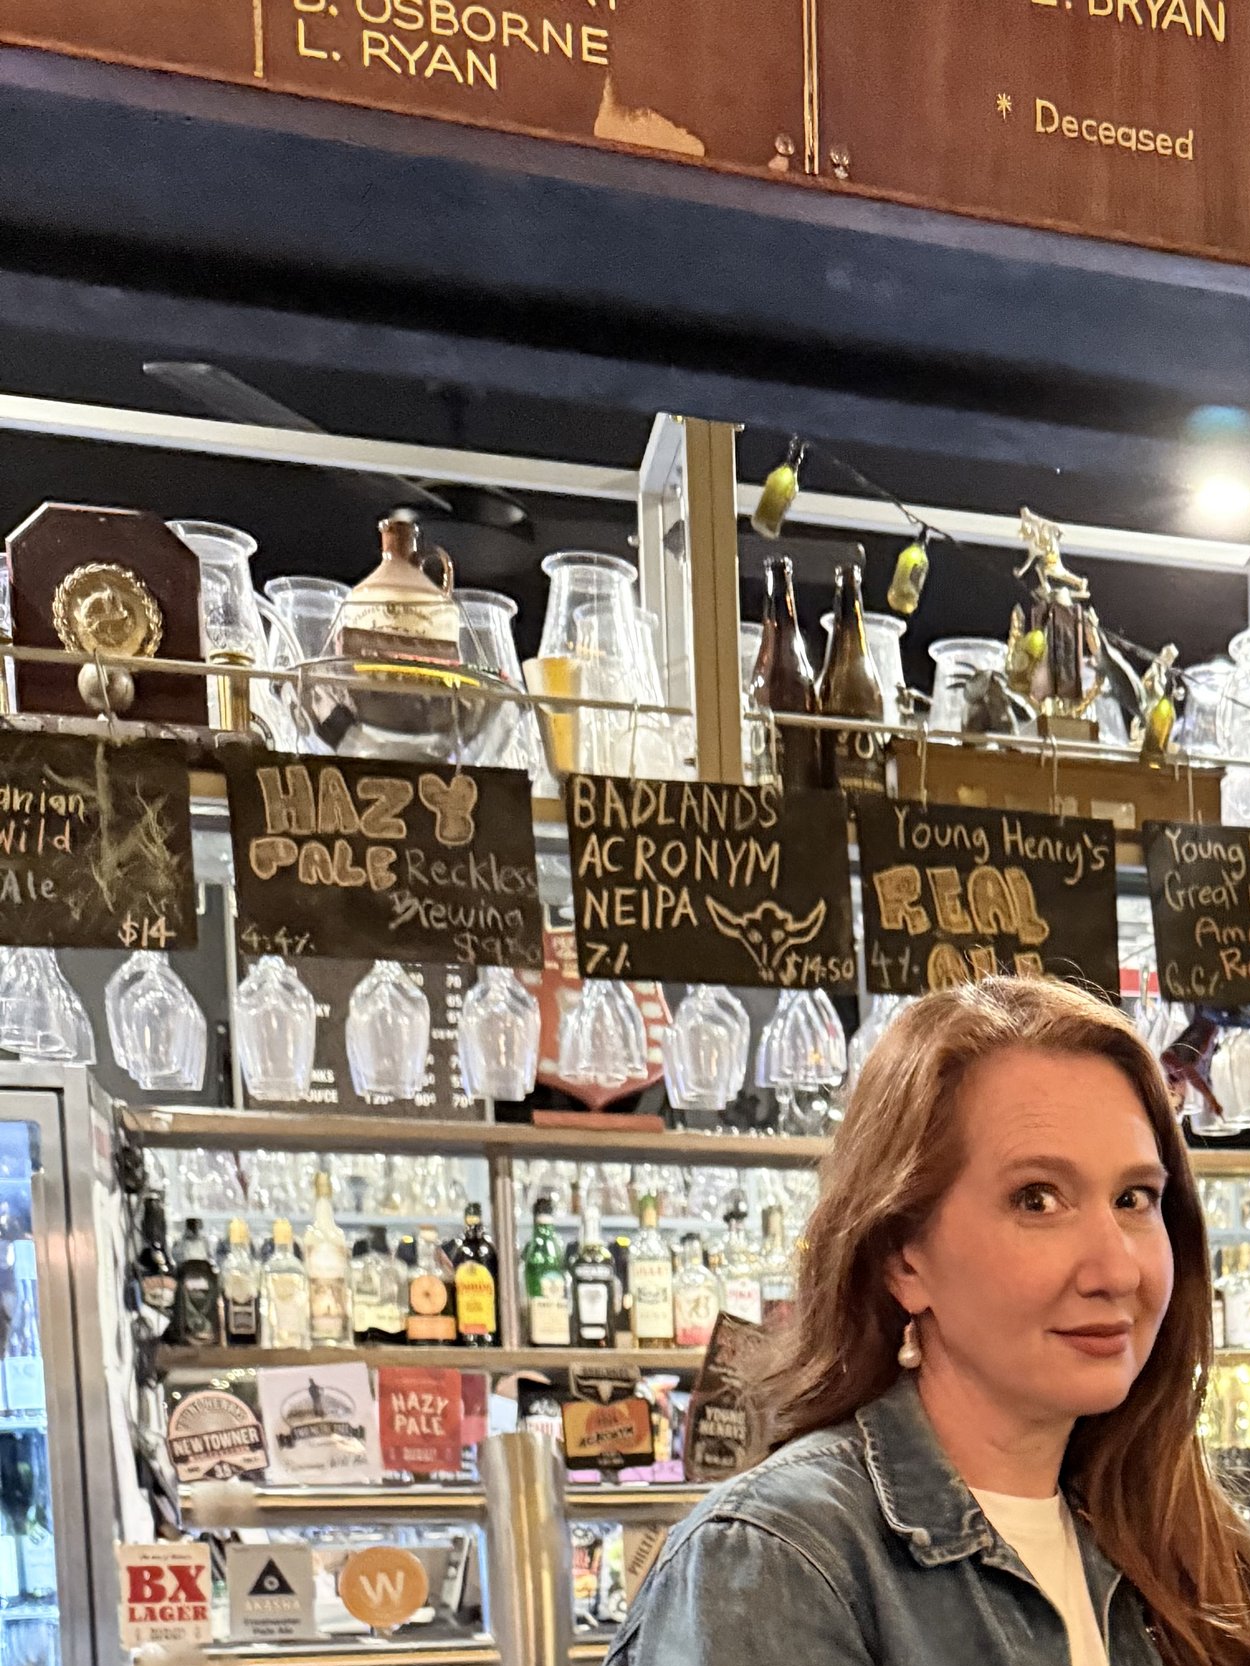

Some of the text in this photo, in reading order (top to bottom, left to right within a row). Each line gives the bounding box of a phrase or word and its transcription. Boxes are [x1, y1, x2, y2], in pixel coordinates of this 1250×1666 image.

[297, 18, 498, 90] L. RYAN
[356, 0, 609, 65] OSBORNE
[1036, 98, 1195, 161] Deceased
[255, 765, 478, 846] HAZY
[572, 775, 779, 832] BADLANDS
[249, 836, 397, 892] PALE
[577, 835, 781, 890] ACRONYM
[894, 805, 1109, 886] Young Henry's
[1164, 827, 1247, 881] Young
[117, 910, 178, 949] $14
[582, 885, 699, 931] NEIPA
[872, 864, 1050, 946] REAL
[390, 1392, 449, 1415] HAZY
[393, 1414, 447, 1437] PALE
[172, 1426, 260, 1458] NEWTOWNER
[126, 1564, 207, 1603] BX
[358, 1571, 405, 1607] W
[128, 1605, 209, 1623] LAGER
